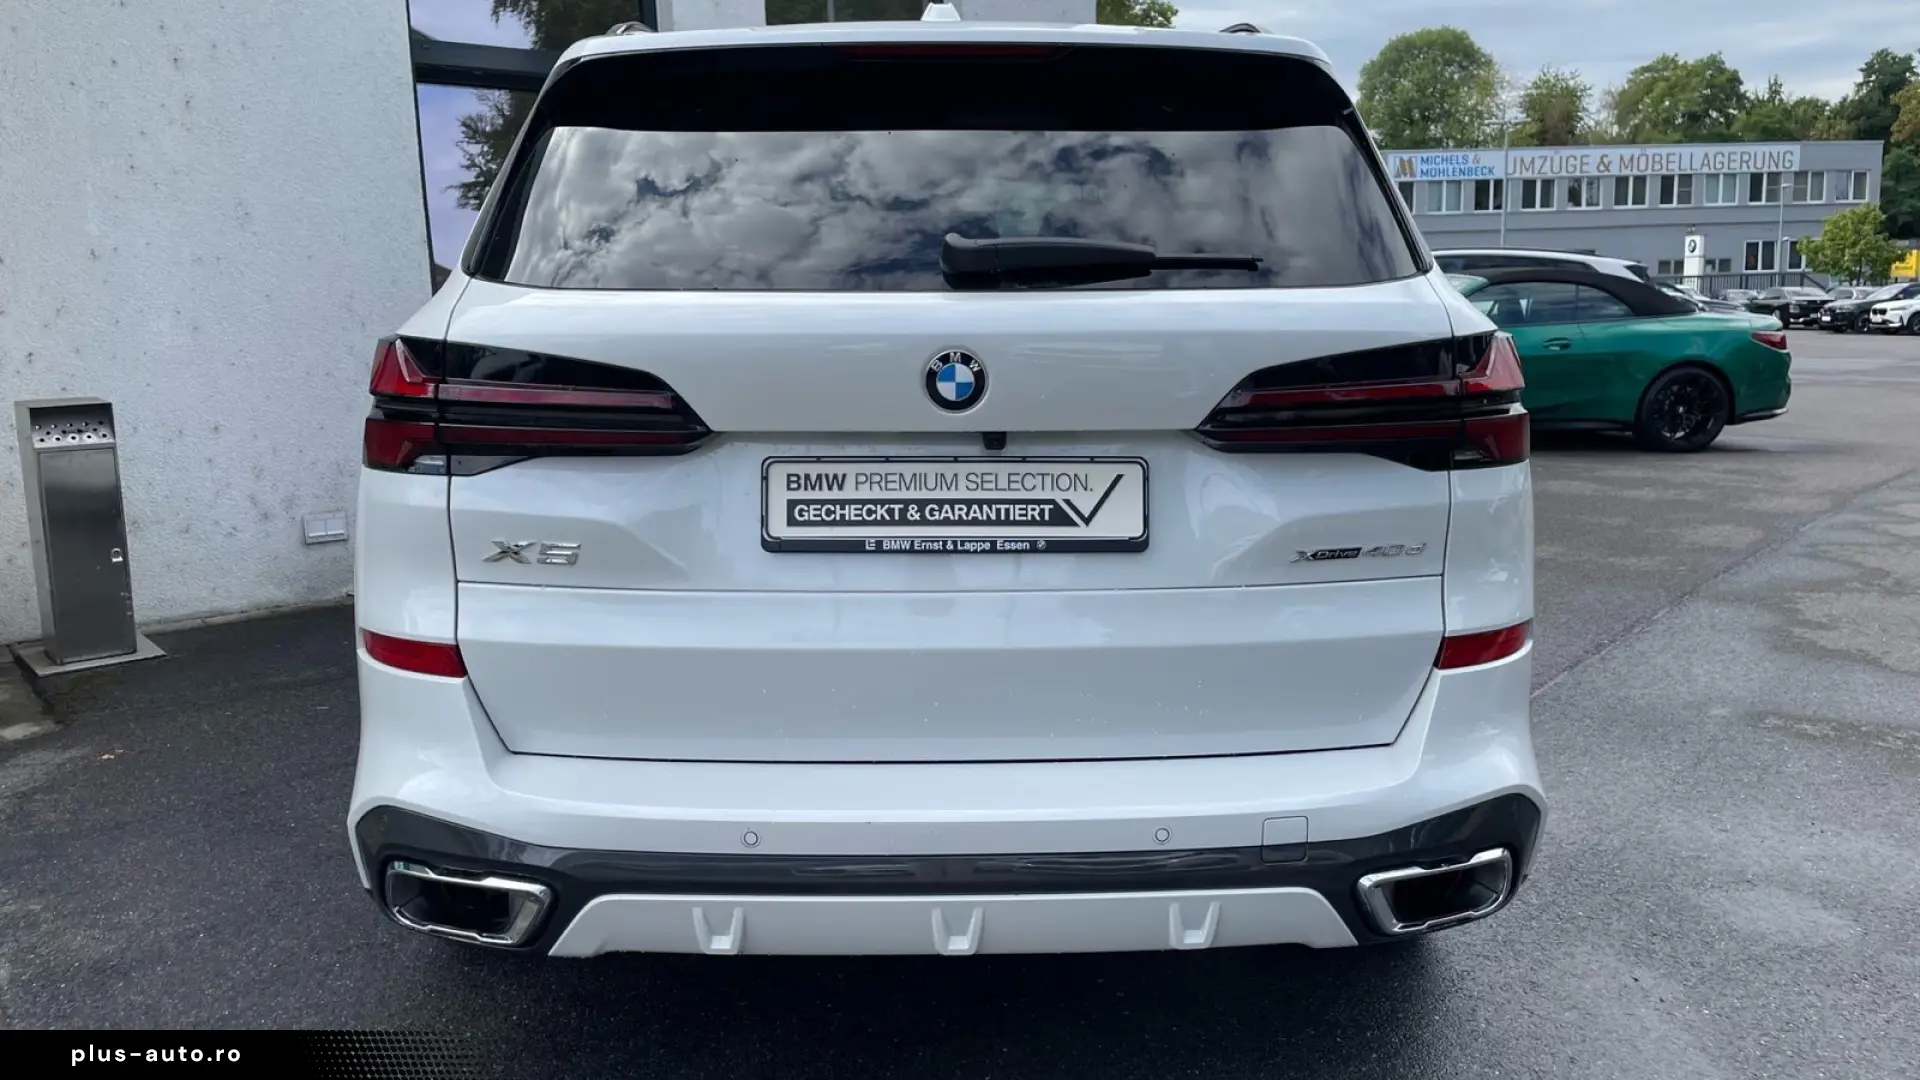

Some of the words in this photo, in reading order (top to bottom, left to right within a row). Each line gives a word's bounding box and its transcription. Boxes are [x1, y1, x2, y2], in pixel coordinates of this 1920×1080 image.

[1420, 154, 1469, 166] MICHELS
[1471, 153, 1482, 165] &
[1596, 153, 1612, 173] &
[1619, 147, 1794, 173] MÖBELLAGERUNG
[930, 352, 982, 372] BMW
[786, 473, 847, 492] BMW
[855, 473, 958, 492] PREMIUM
[965, 473, 1094, 492] SELECTION.
[793, 504, 904, 522] GECHECKT
[907, 504, 921, 522] &
[924, 504, 1054, 522] GARANTIERT
[481, 540, 581, 565] X5
[882, 540, 911, 551] BMW
[914, 540, 943, 551] Ernst
[945, 540, 954, 551] &
[957, 540, 990, 552] Lappe
[997, 540, 1030, 551] Essen
